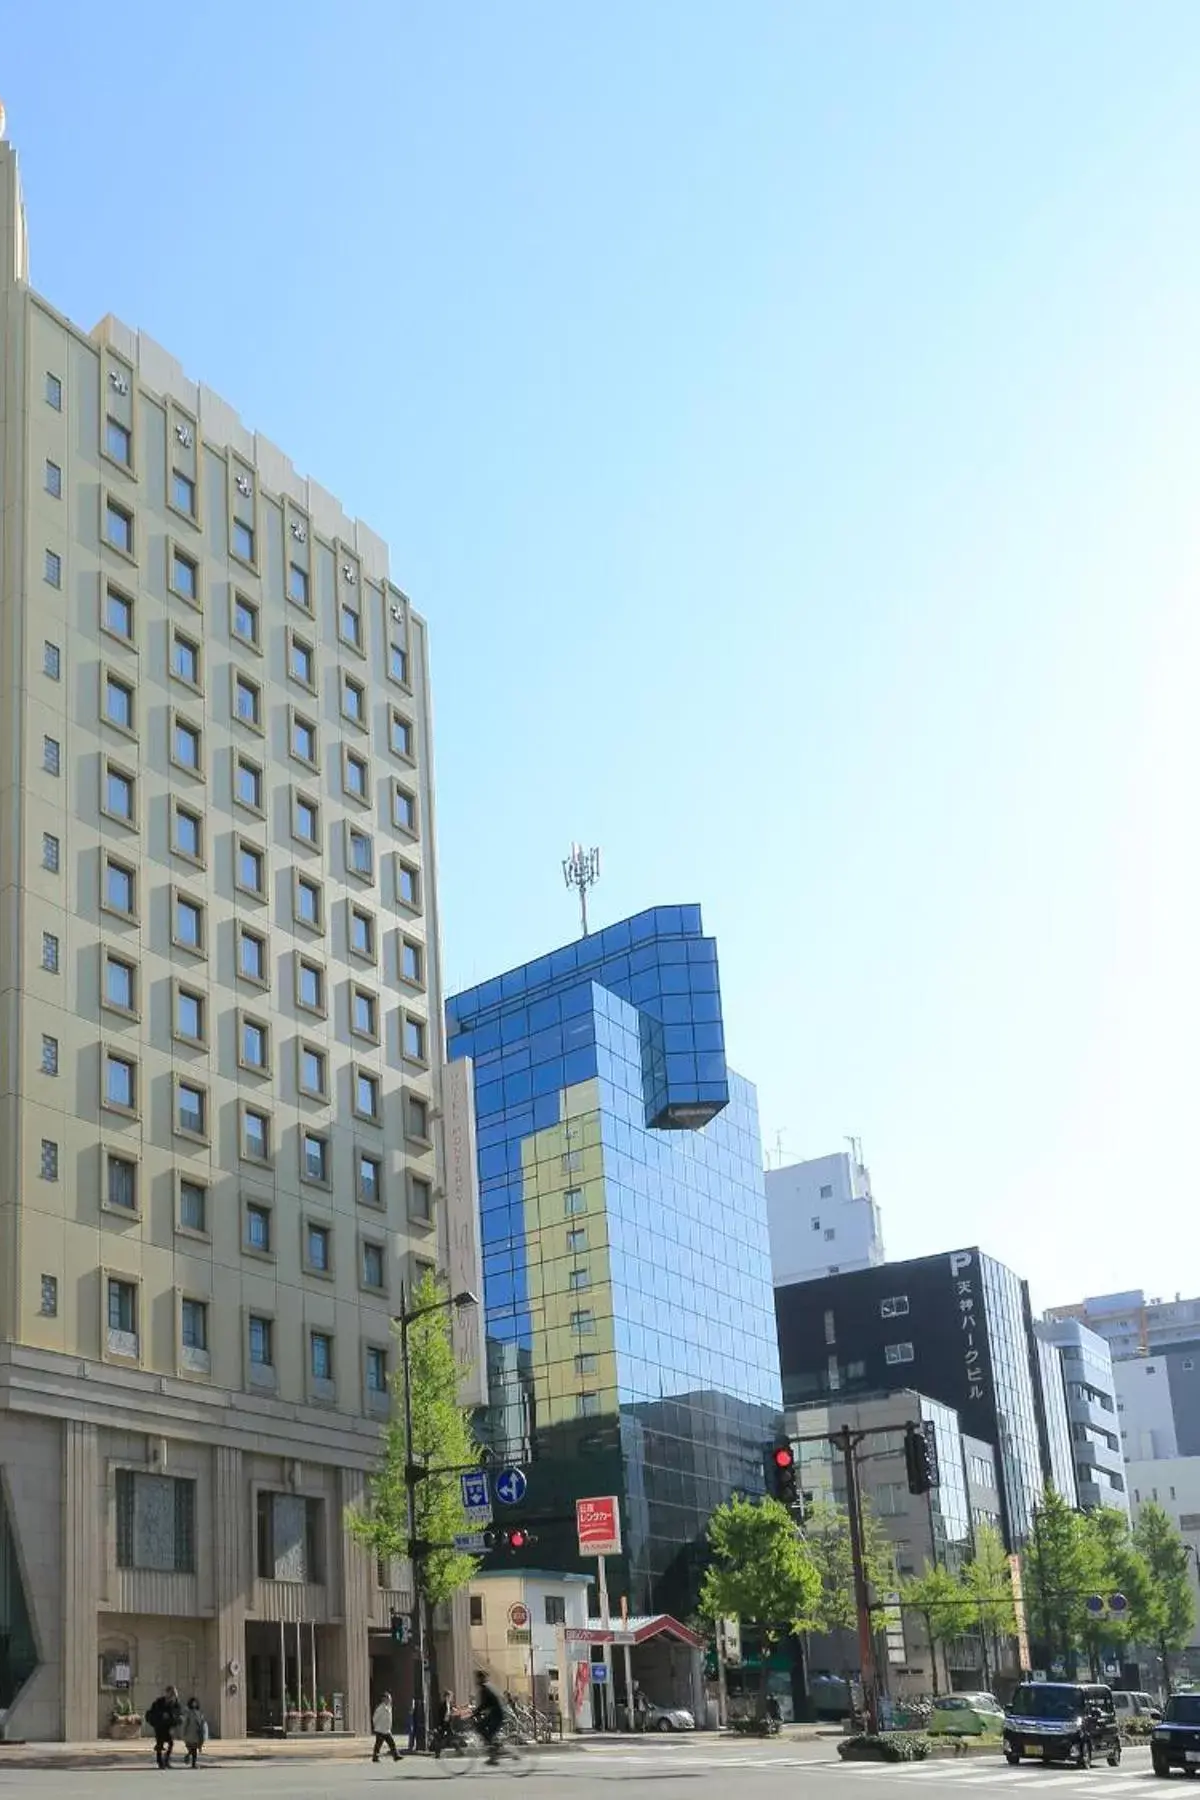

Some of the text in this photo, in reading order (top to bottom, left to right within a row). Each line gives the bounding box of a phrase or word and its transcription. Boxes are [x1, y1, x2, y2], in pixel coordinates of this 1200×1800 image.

[950, 1252, 984, 1400] P 天神パークビル
[580, 1511, 612, 1522] レンタカー
